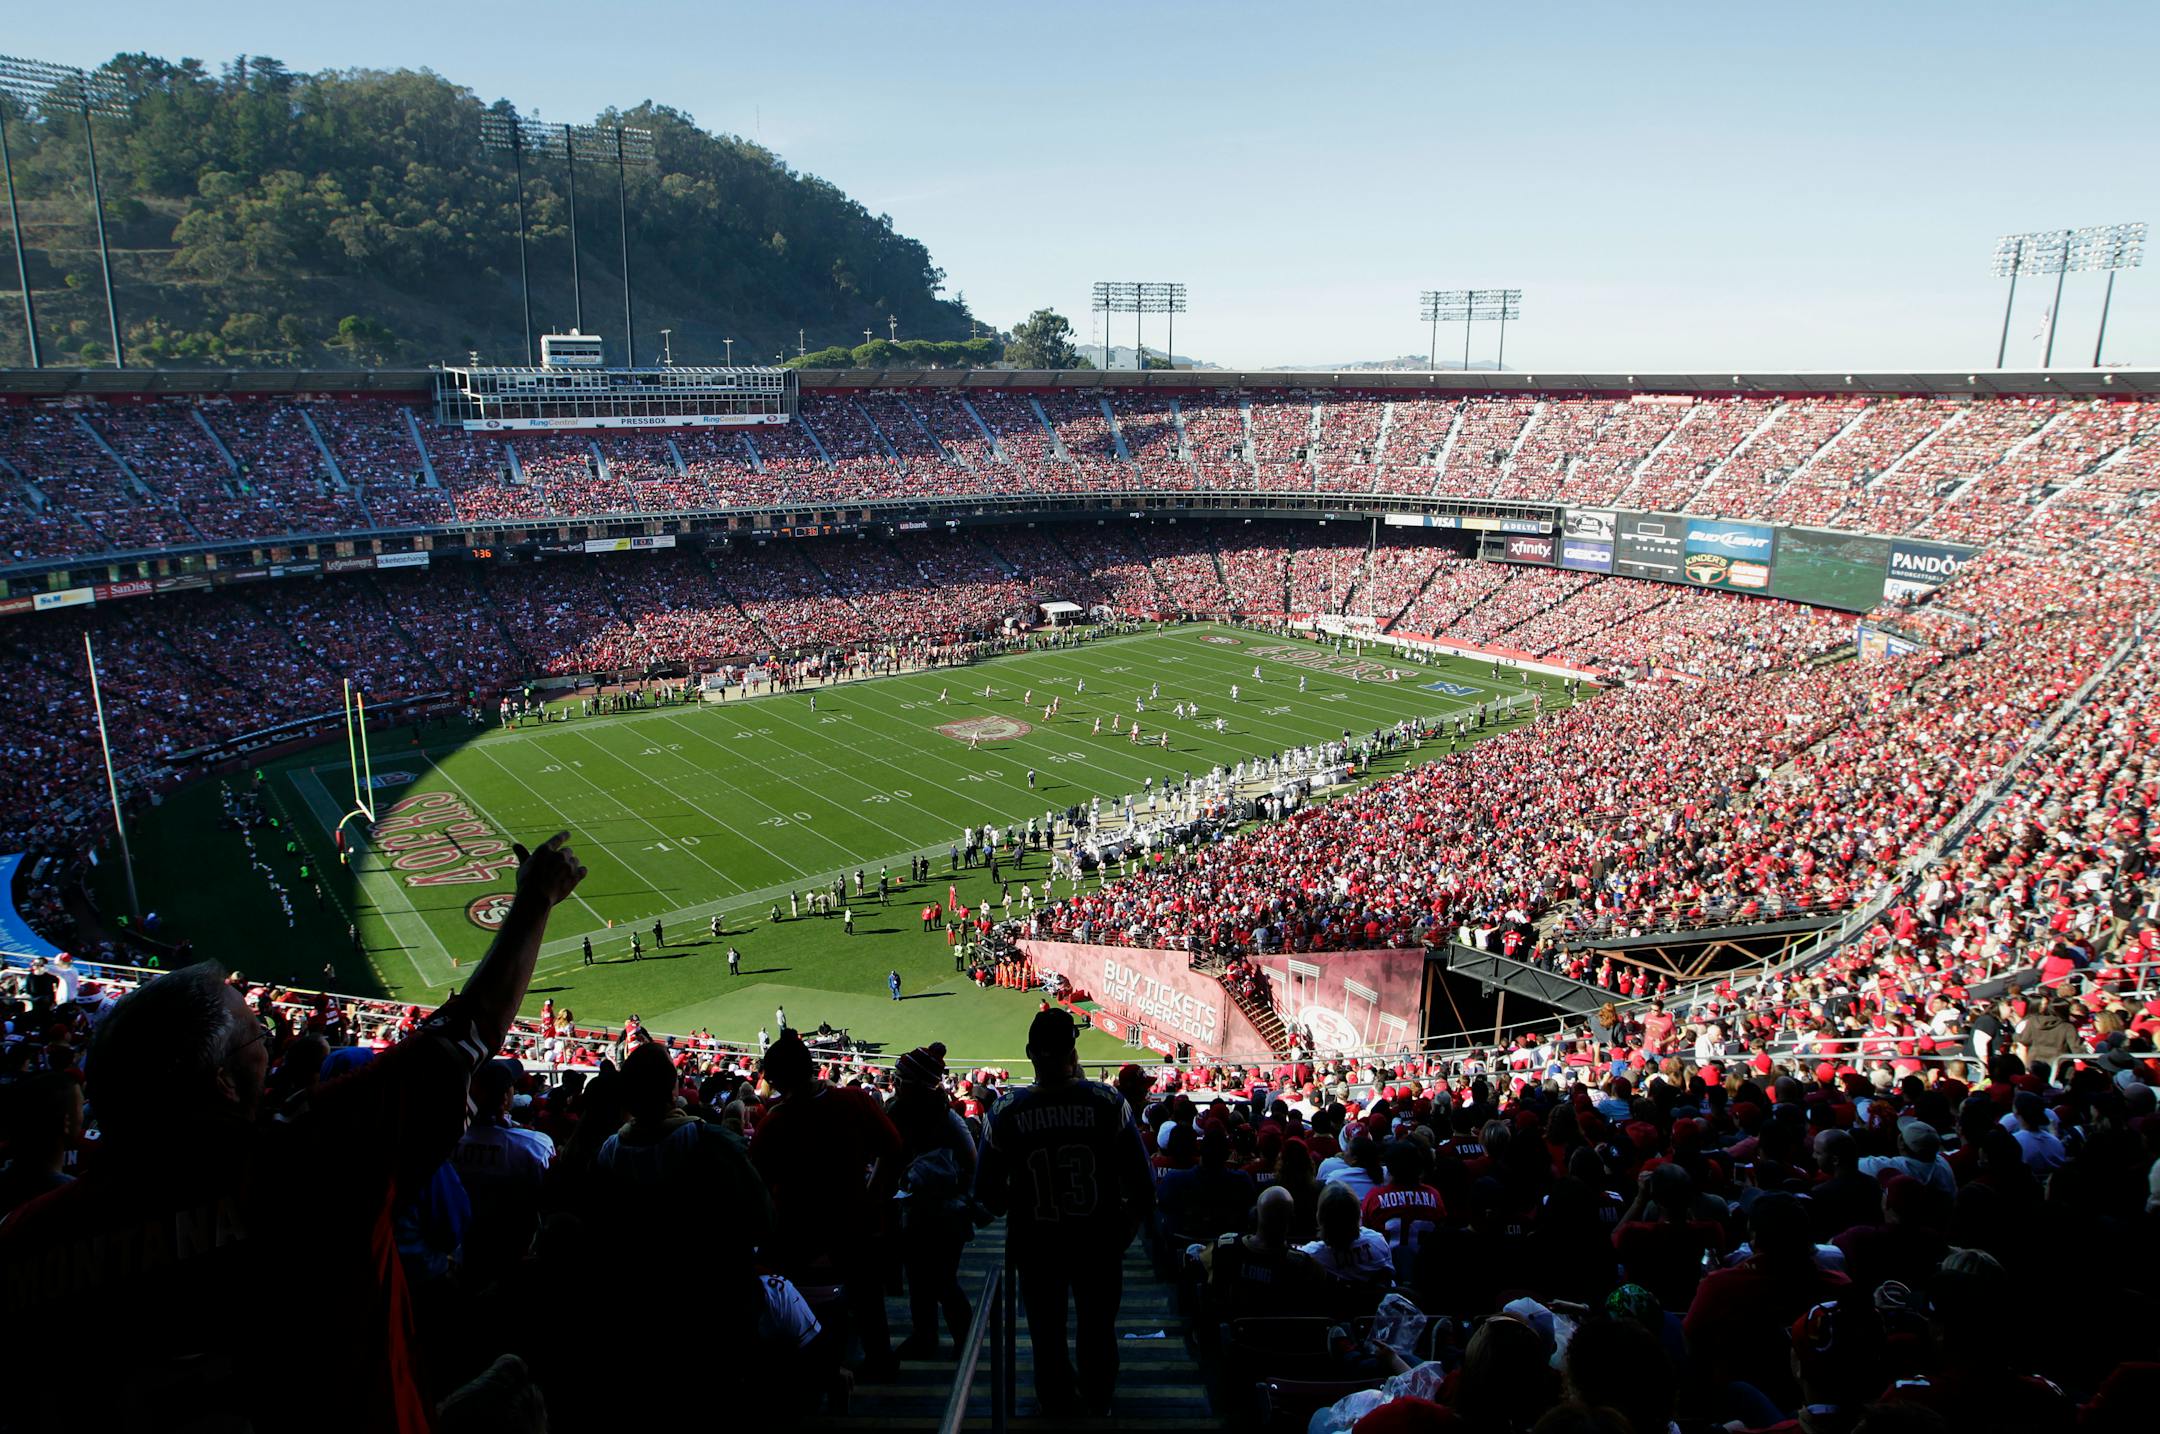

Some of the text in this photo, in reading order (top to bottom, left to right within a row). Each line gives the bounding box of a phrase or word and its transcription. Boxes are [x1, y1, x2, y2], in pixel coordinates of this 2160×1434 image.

[530, 418, 579, 428] RingCentral
[703, 415, 747, 424] RingCentral
[1430, 516, 1455, 528] VISA
[1510, 521, 1537, 531] DELTA
[1687, 531, 1720, 542] BUD
[1728, 535, 1770, 548] LIGHT
[1564, 548, 1611, 562] GEICO
[1684, 553, 1728, 567] KINDER'S
[111, 581, 153, 595] SanDisk
[1243, 645, 1421, 684] 49ERS
[1048, 751, 1087, 763] 50
[872, 789, 913, 804] 30
[767, 811, 813, 828] 20
[360, 791, 520, 888] 49ERS
[654, 835, 701, 853] 10
[1103, 958, 1217, 1028] BUY TICKETS
[1103, 979, 1214, 1045] VISIT 49ERS.COM
[1013, 1105, 1096, 1134] WARNER
[1024, 1143, 1099, 1223] 13
[1377, 1190, 1437, 1209] MONTANA
